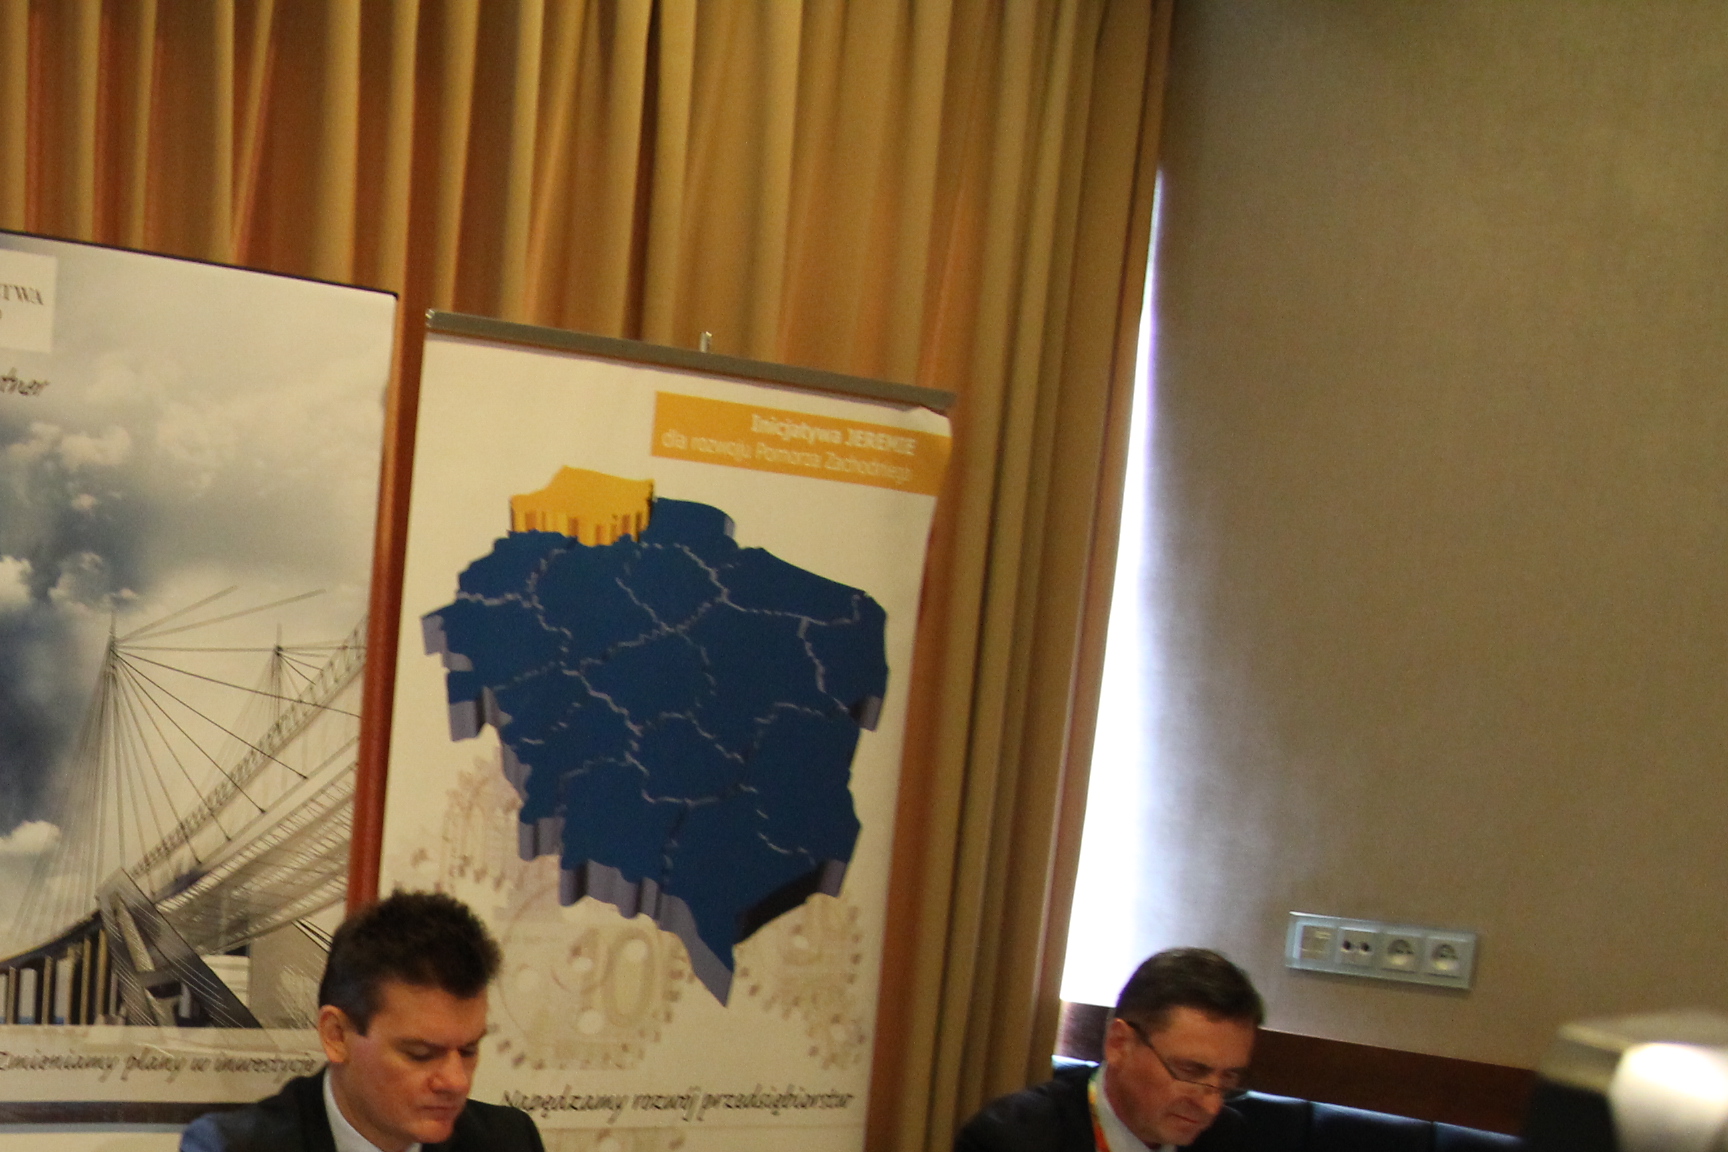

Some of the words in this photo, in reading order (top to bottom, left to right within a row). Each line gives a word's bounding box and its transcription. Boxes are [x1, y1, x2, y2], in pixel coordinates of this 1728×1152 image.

[660, 429, 687, 450] dla
[690, 436, 753, 462] rozwoju
[755, 441, 823, 469] Pomorza
[751, 413, 843, 445] Inicjatywa
[845, 428, 917, 456] JEREMIE
[120, 1047, 188, 1084] plany
[189, 1058, 207, 1073] w
